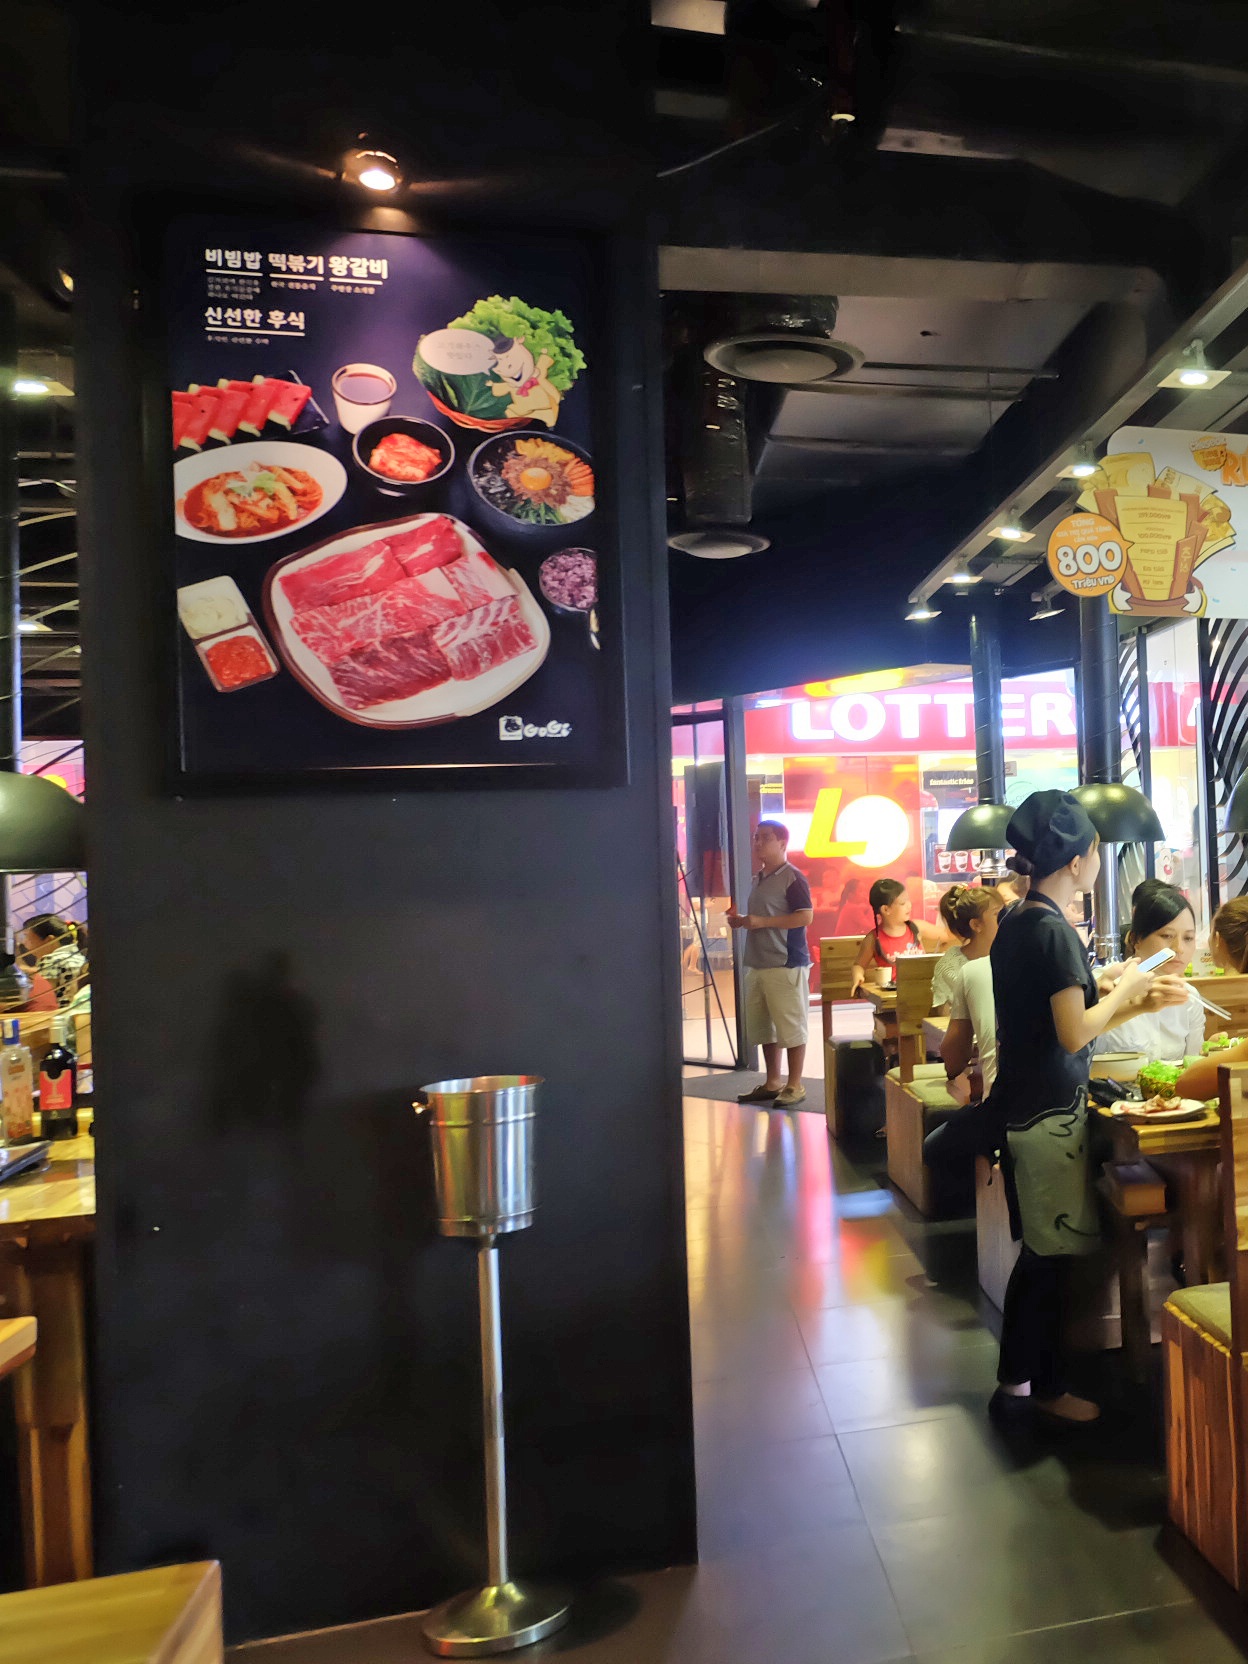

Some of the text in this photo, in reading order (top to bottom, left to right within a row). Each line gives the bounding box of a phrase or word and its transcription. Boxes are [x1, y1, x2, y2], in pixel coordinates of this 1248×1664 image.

[205, 249, 262, 269] 비빔밥
[328, 255, 388, 279] 왕갈비
[205, 307, 305, 330] 신선한 후식
[1056, 541, 1122, 577] 800
[791, 692, 1077, 742] LOTTER
